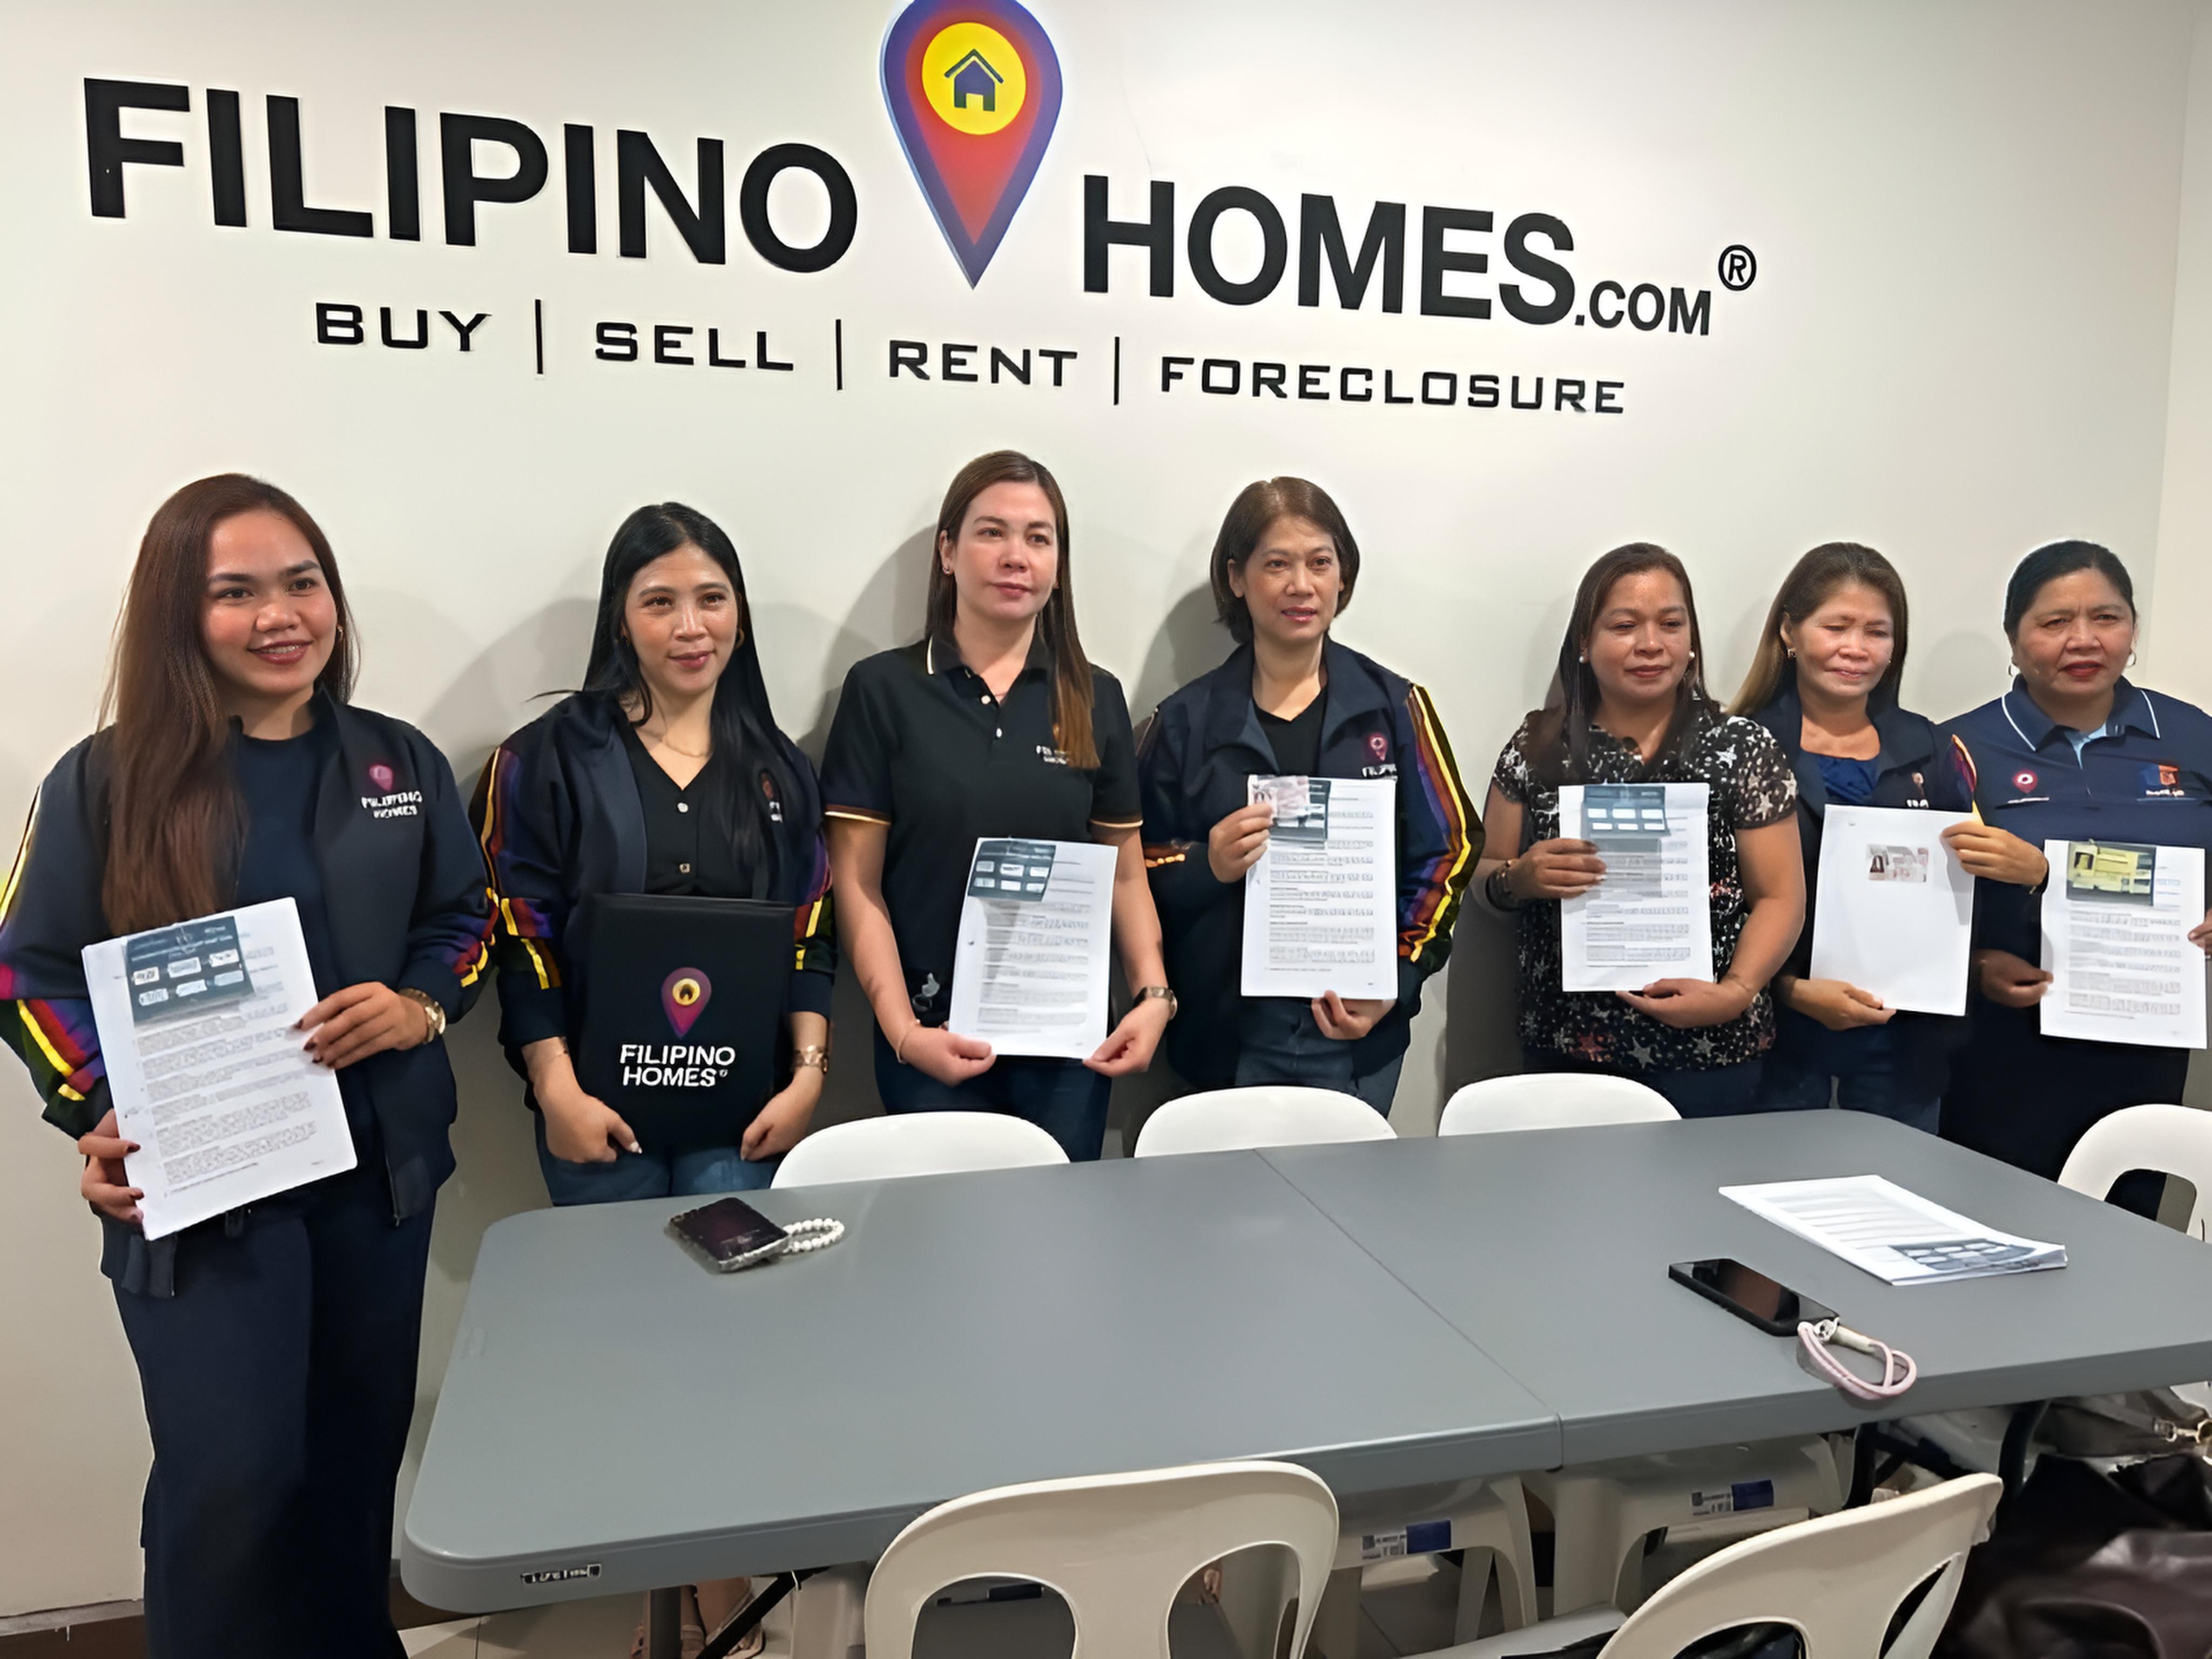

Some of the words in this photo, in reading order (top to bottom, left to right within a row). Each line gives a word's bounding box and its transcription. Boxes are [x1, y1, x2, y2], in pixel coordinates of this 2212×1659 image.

[84, 77, 858, 273] FILIPINO
[315, 302, 492, 352] BUY
[595, 321, 794, 372] SELL
[889, 340, 1078, 387] RENT
[1161, 356, 1625, 414] FORECLOSURE
[619, 1044, 736, 1067] FILIPINO
[623, 1066, 717, 1087] HOMES
